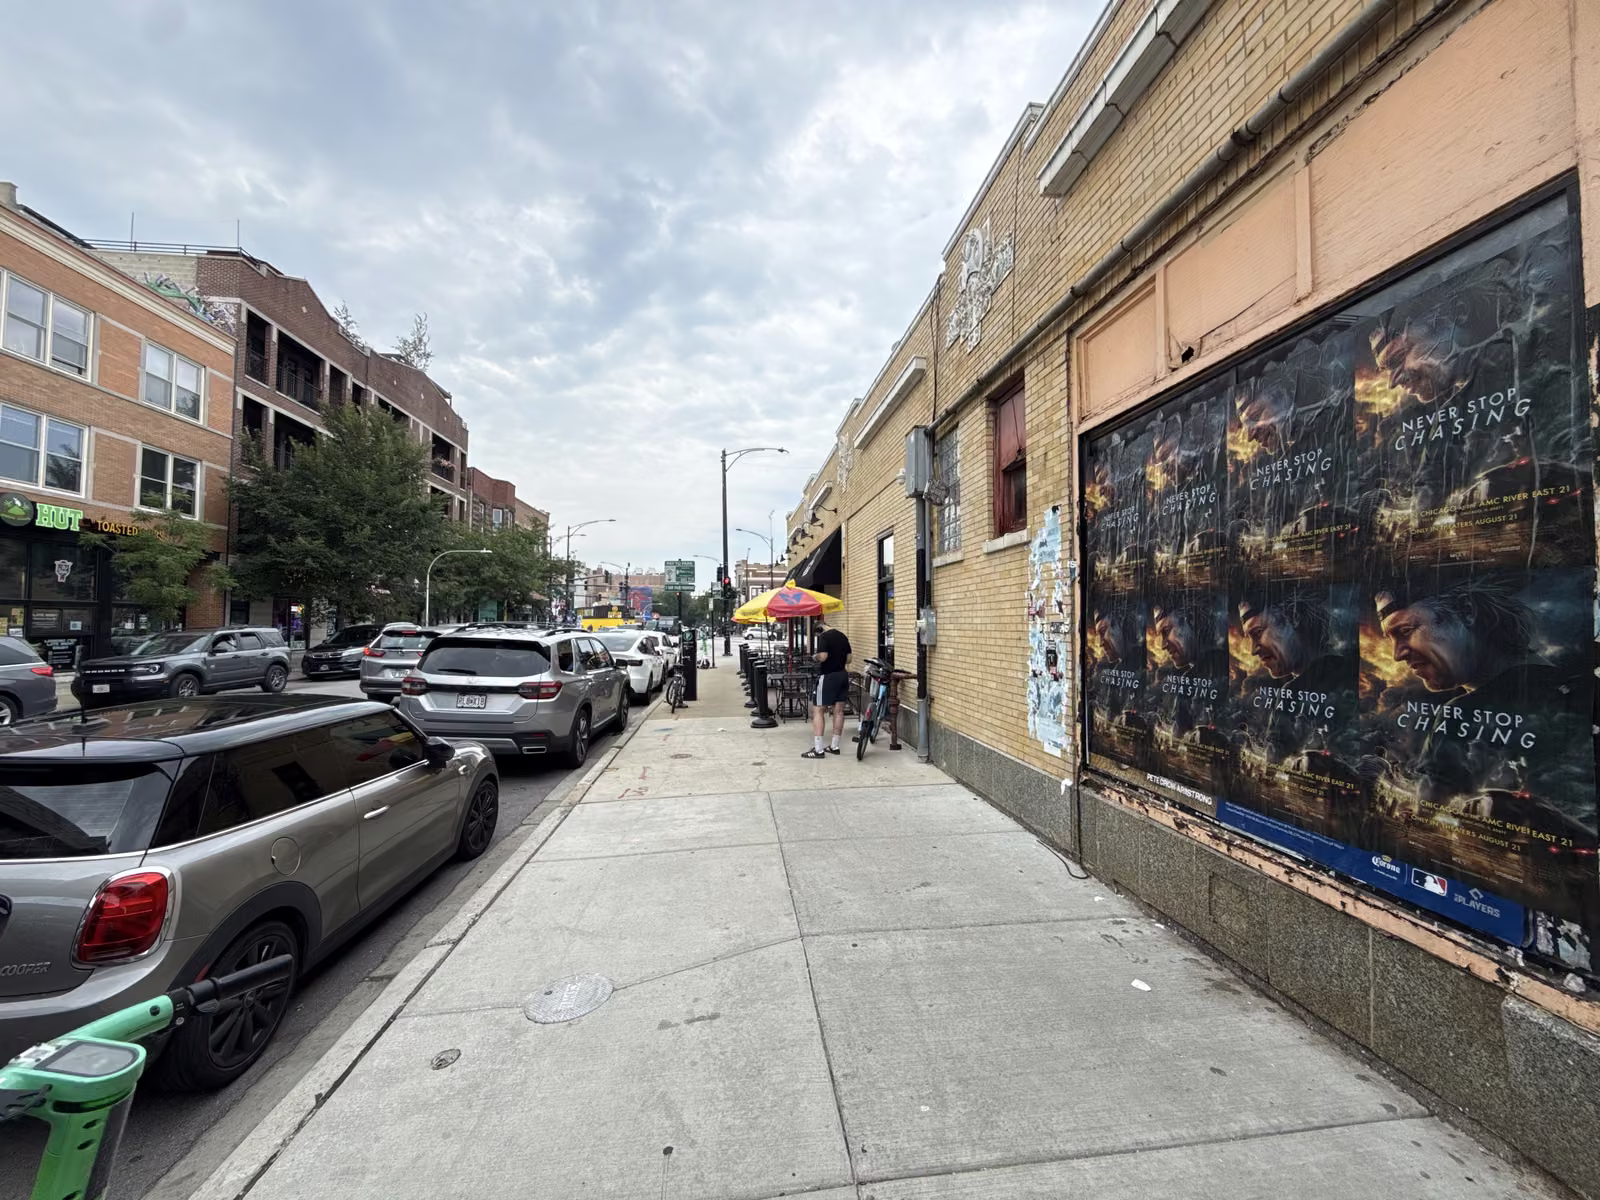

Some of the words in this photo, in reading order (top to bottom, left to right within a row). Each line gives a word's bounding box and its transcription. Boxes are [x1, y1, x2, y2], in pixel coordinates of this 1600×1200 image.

[1402, 407, 1457, 433] NEVER
[1467, 388, 1517, 413] STOP
[1395, 398, 1531, 451] CHASING
[1249, 457, 1332, 490] CHASING
[1257, 459, 1289, 477] NEVER
[1294, 448, 1323, 466] STOP
[1162, 492, 1216, 516] CHASING
[1166, 491, 1189, 504] NEVER
[1191, 483, 1211, 497] STOP
[1420, 505, 1457, 518] CHICAGO
[1479, 497, 1501, 507] AMC
[1502, 492, 1529, 504] RIVER
[1531, 486, 1556, 499] EAST
[1558, 485, 1570, 495] 21
[36, 503, 83, 531] HUT
[97, 520, 138, 536] TOASTED
[1410, 527, 1428, 536] ONLY
[1439, 521, 1473, 532] THEATERS
[1475, 515, 1506, 526] AUGUST
[1508, 513, 1518, 521] 21
[1100, 675, 1140, 689] CHASING
[1103, 669, 1119, 678] NEVER
[1120, 670, 1135, 679] STOP
[1166, 675, 1190, 685] NEVER
[1194, 678, 1213, 688] STOP
[1162, 683, 1218, 700] CHASING
[1259, 686, 1293, 700] NEVER
[1297, 690, 1328, 704] STOP
[1253, 695, 1336, 719] CHASING
[1407, 700, 1463, 720] NEVER
[1473, 709, 1523, 728] STOP
[1397, 713, 1537, 749] CHASING
[1146, 773, 1160, 785] PETE
[1315, 775, 1331, 783] RIVER
[1331, 778, 1345, 787] EAST
[1411, 814, 1430, 825] ONLY
[1430, 819, 1439, 827] IN
[1441, 822, 1476, 838] THEATERS
[1478, 833, 1508, 848] AUGUST
[1511, 843, 1521, 851] 21
[1419, 799, 1464, 815] CHICAGO
[1482, 816, 1503, 829] AMC
[1532, 830, 1556, 843] EAST
[1560, 838, 1573, 848] 21
[1372, 855, 1400, 874] Corona
[1458, 893, 1500, 919] PLAYERS
[1, 961, 51, 977] COOPER
